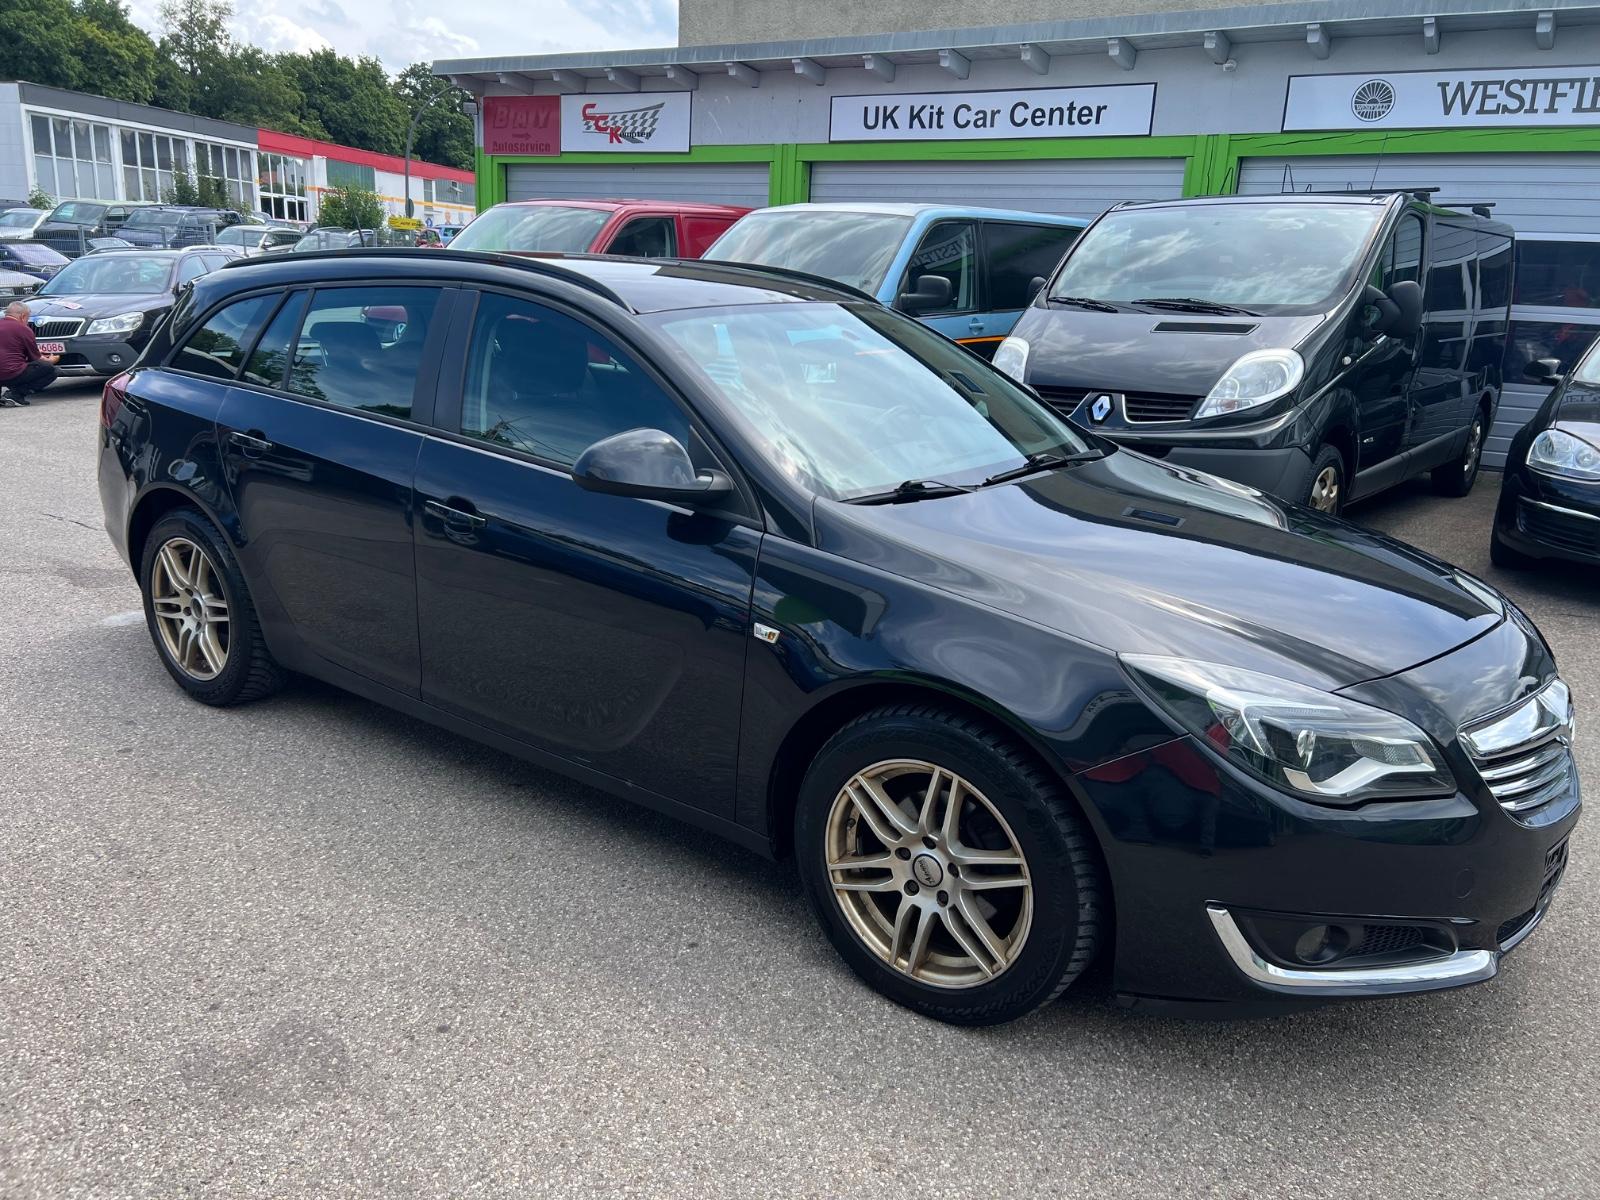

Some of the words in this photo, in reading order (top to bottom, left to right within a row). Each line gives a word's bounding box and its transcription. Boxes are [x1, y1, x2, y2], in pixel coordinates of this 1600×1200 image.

[863, 105, 900, 130] UK
[908, 104, 945, 129] Kit
[953, 103, 1001, 129] Car
[1009, 100, 1107, 128] Center
[492, 141, 551, 153] Autoservice
